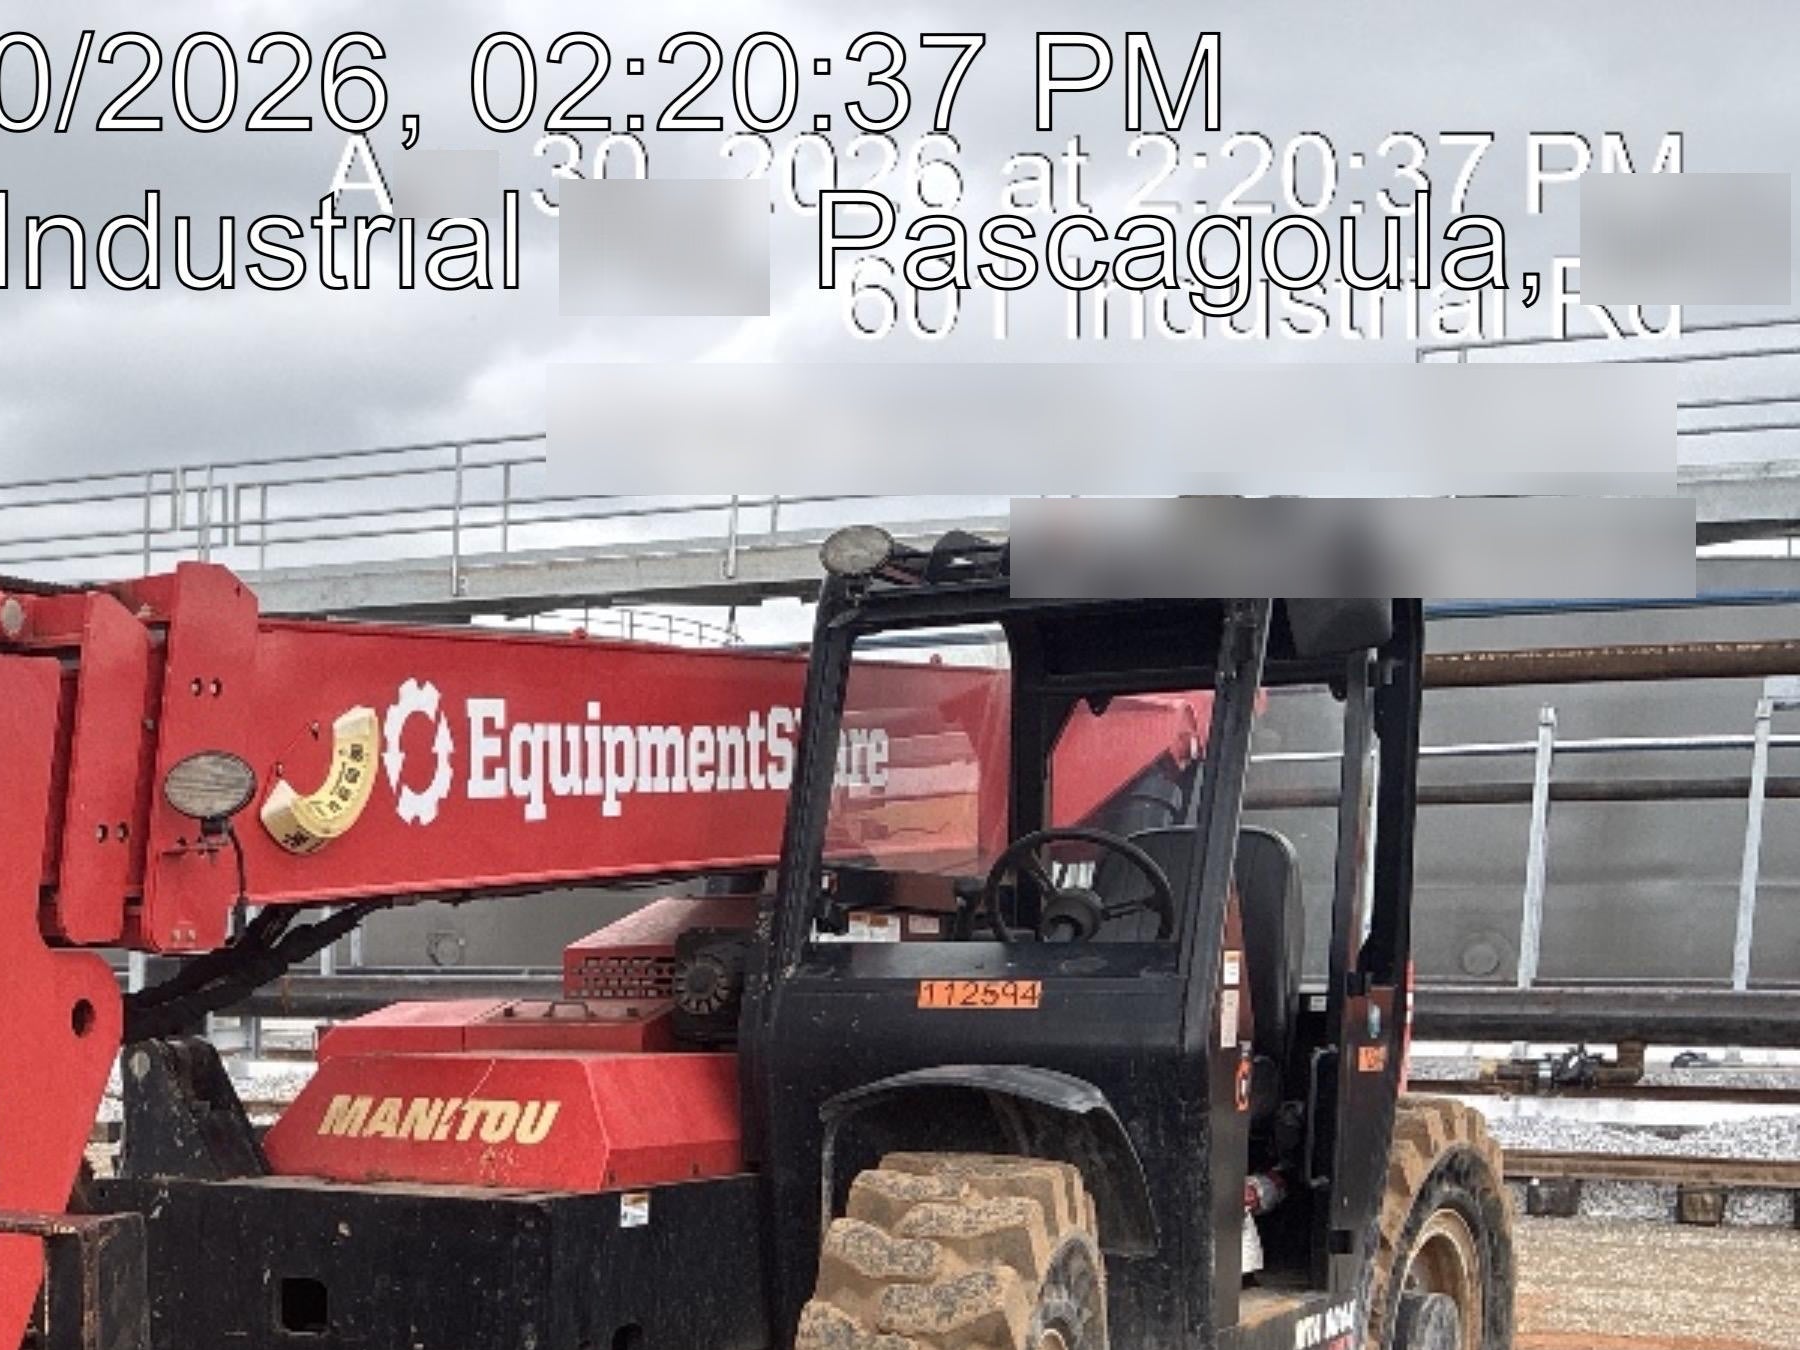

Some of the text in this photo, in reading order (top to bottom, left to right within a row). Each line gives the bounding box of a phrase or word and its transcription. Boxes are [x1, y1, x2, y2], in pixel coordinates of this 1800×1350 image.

[465, 697, 890, 822] EquipmentSare
[922, 981, 1038, 1006] 112594
[316, 1094, 562, 1145] MANITOU
